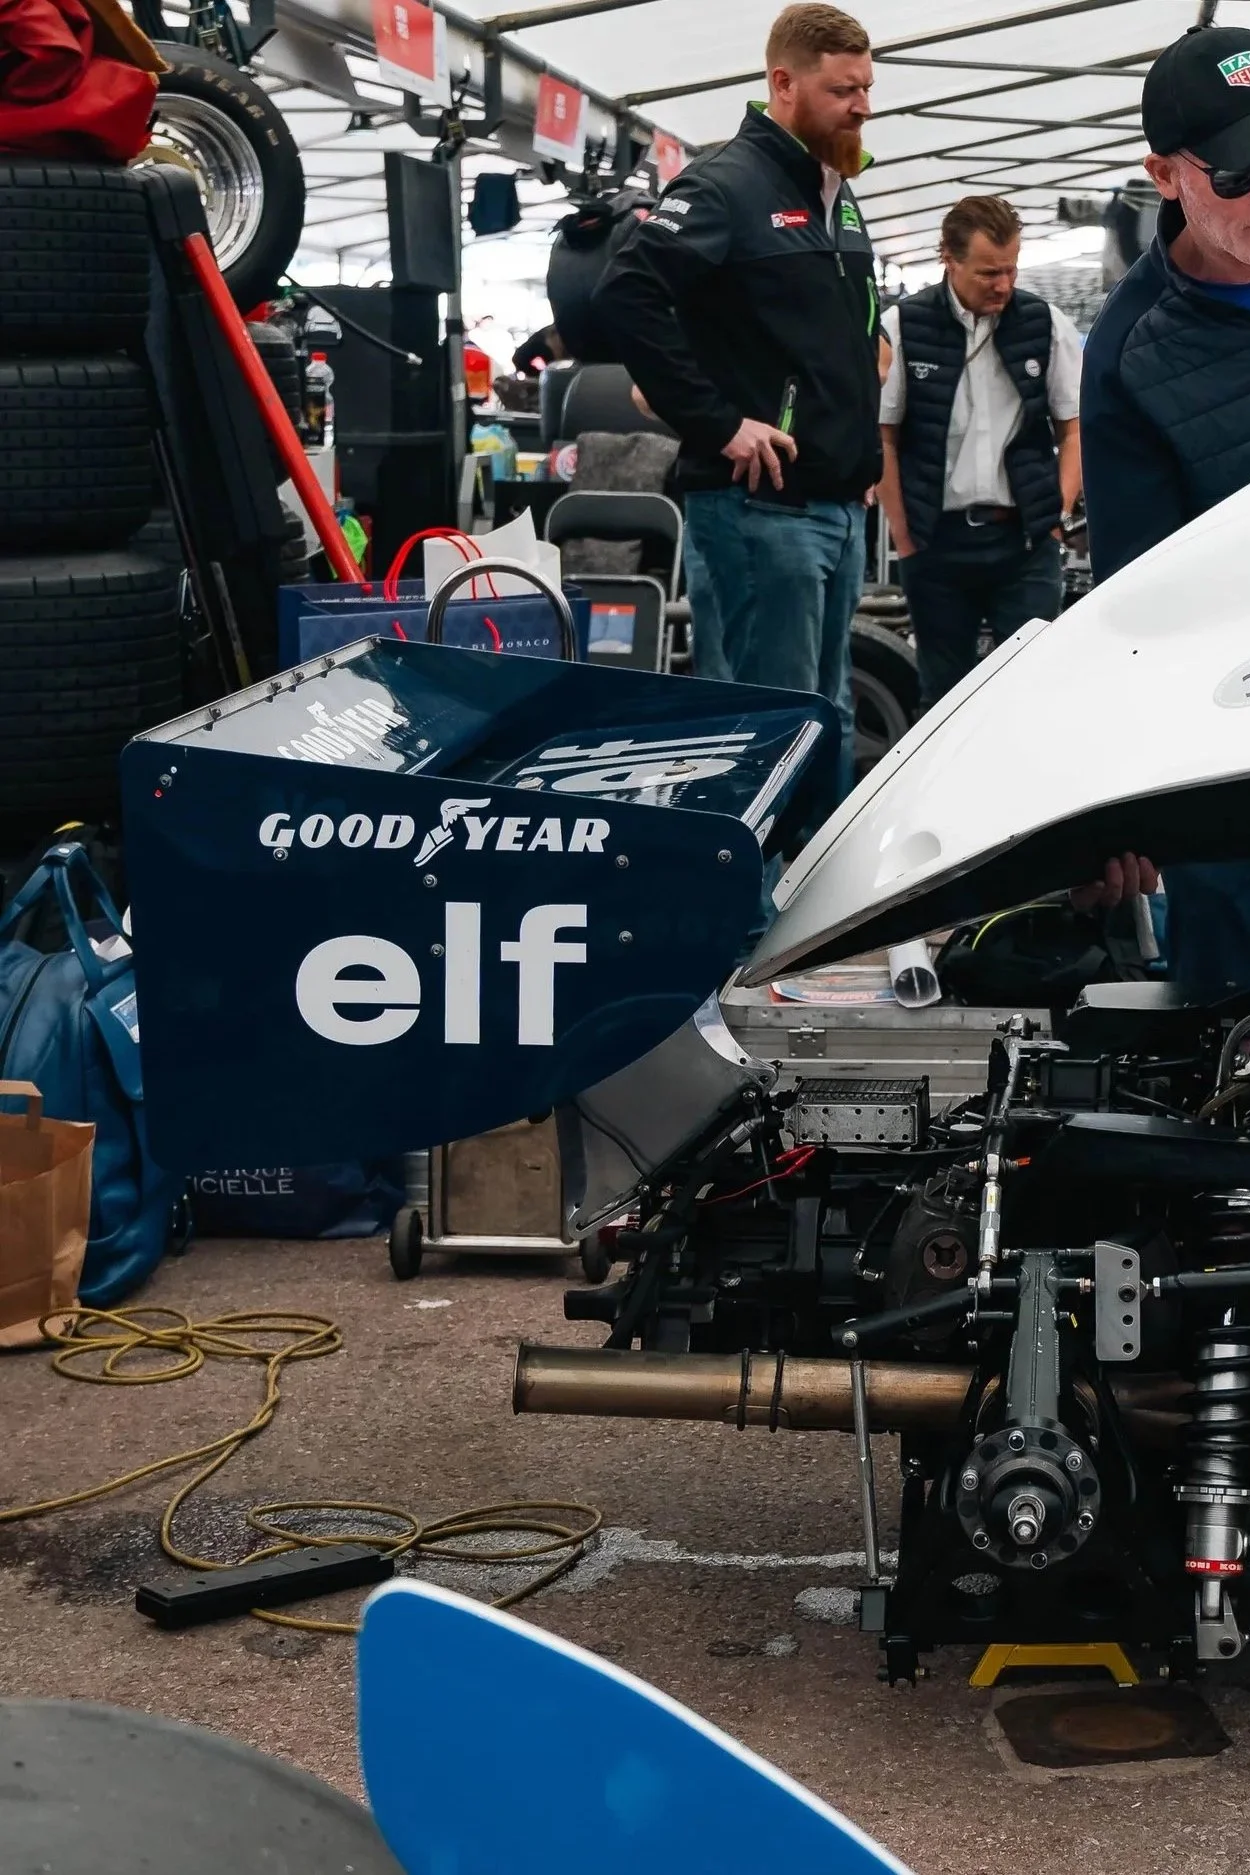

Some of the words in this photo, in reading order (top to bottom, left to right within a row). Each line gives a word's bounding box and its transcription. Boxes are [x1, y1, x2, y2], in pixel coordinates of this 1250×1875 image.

[259, 812, 415, 849] GOOD
[464, 816, 611, 853] YEAR
[295, 901, 588, 1046] elf
[192, 1176, 295, 1195] ICIELLE
